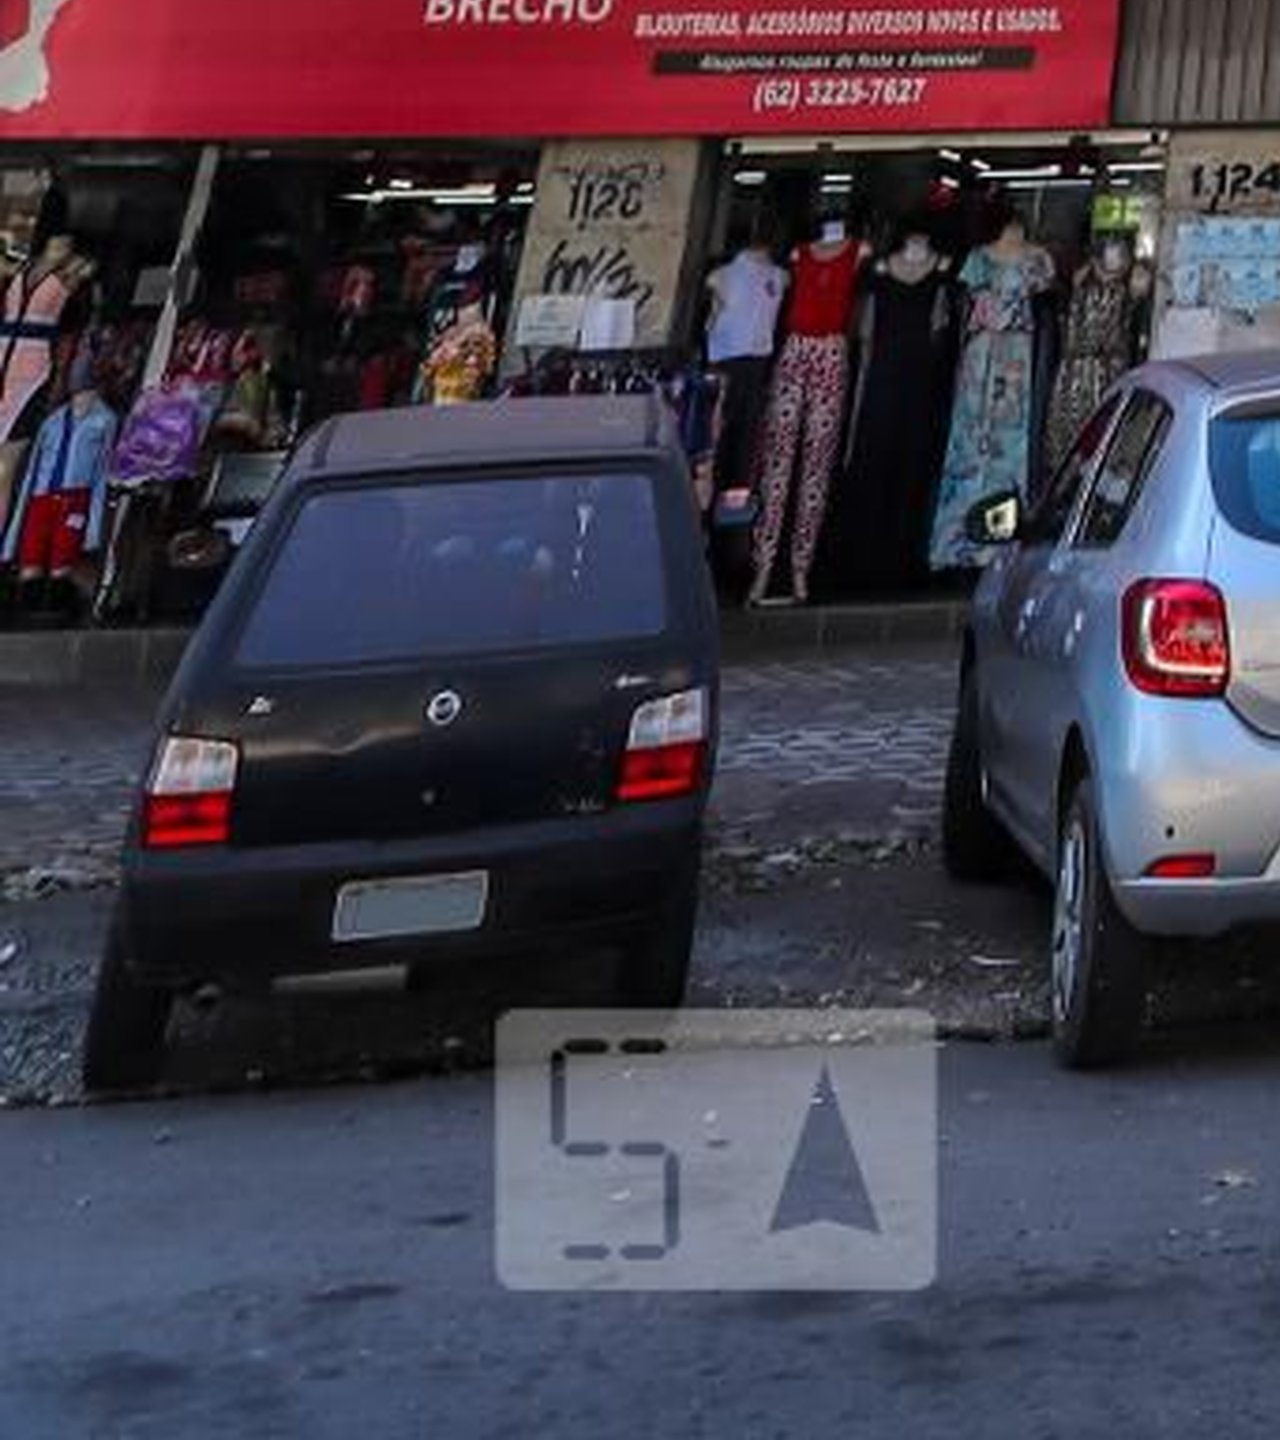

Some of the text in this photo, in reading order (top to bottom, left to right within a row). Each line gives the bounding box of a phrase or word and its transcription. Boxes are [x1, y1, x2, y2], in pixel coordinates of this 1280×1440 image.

[745, 5, 845, 37] ACESSÓRIOS
[847, 10, 925, 36] DIVERSOS
[927, 10, 980, 35] NOVOS
[753, 79, 800, 111] (62)
